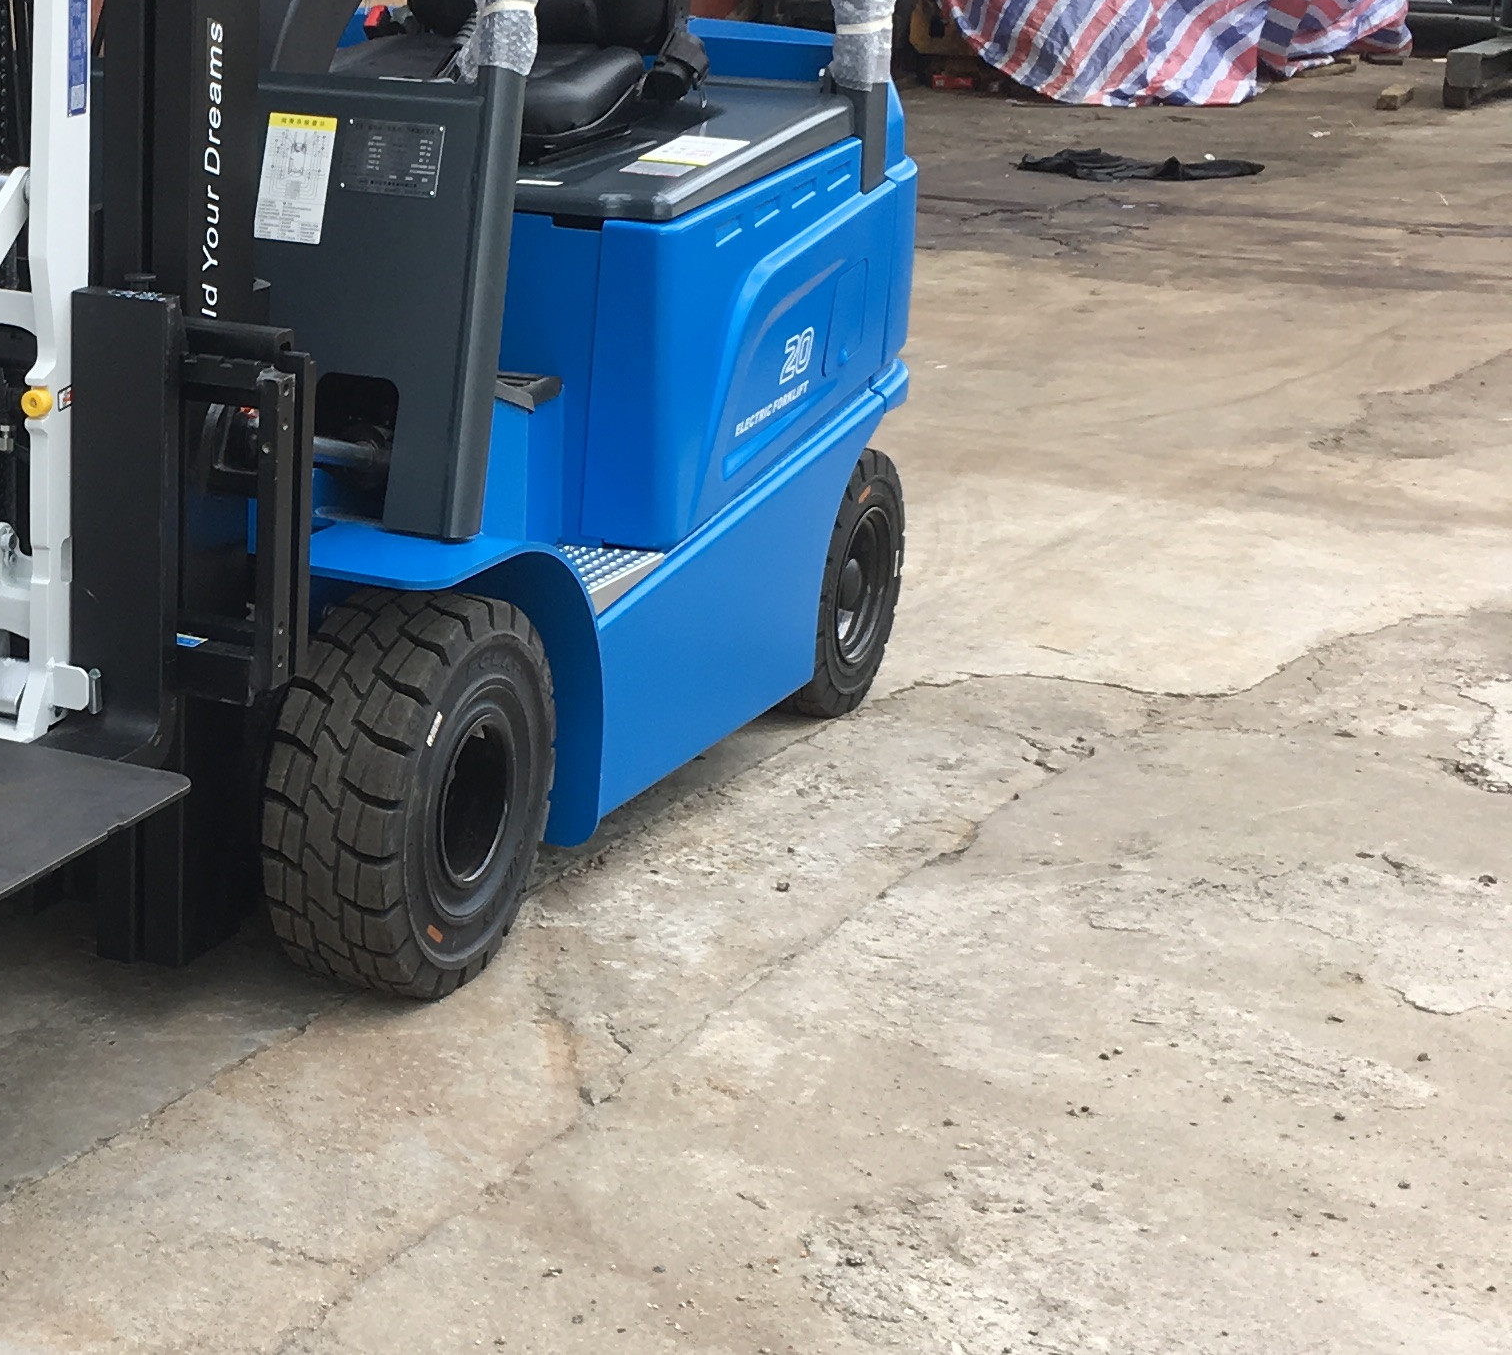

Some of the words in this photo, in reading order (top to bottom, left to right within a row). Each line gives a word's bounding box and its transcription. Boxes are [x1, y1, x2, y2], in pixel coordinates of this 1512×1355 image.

[203, 20, 224, 176] Dreams
[201, 183, 220, 273] Your
[778, 325, 815, 386] 20
[734, 403, 773, 438] ELECTRIC
[772, 379, 810, 414] FORKLIFT
